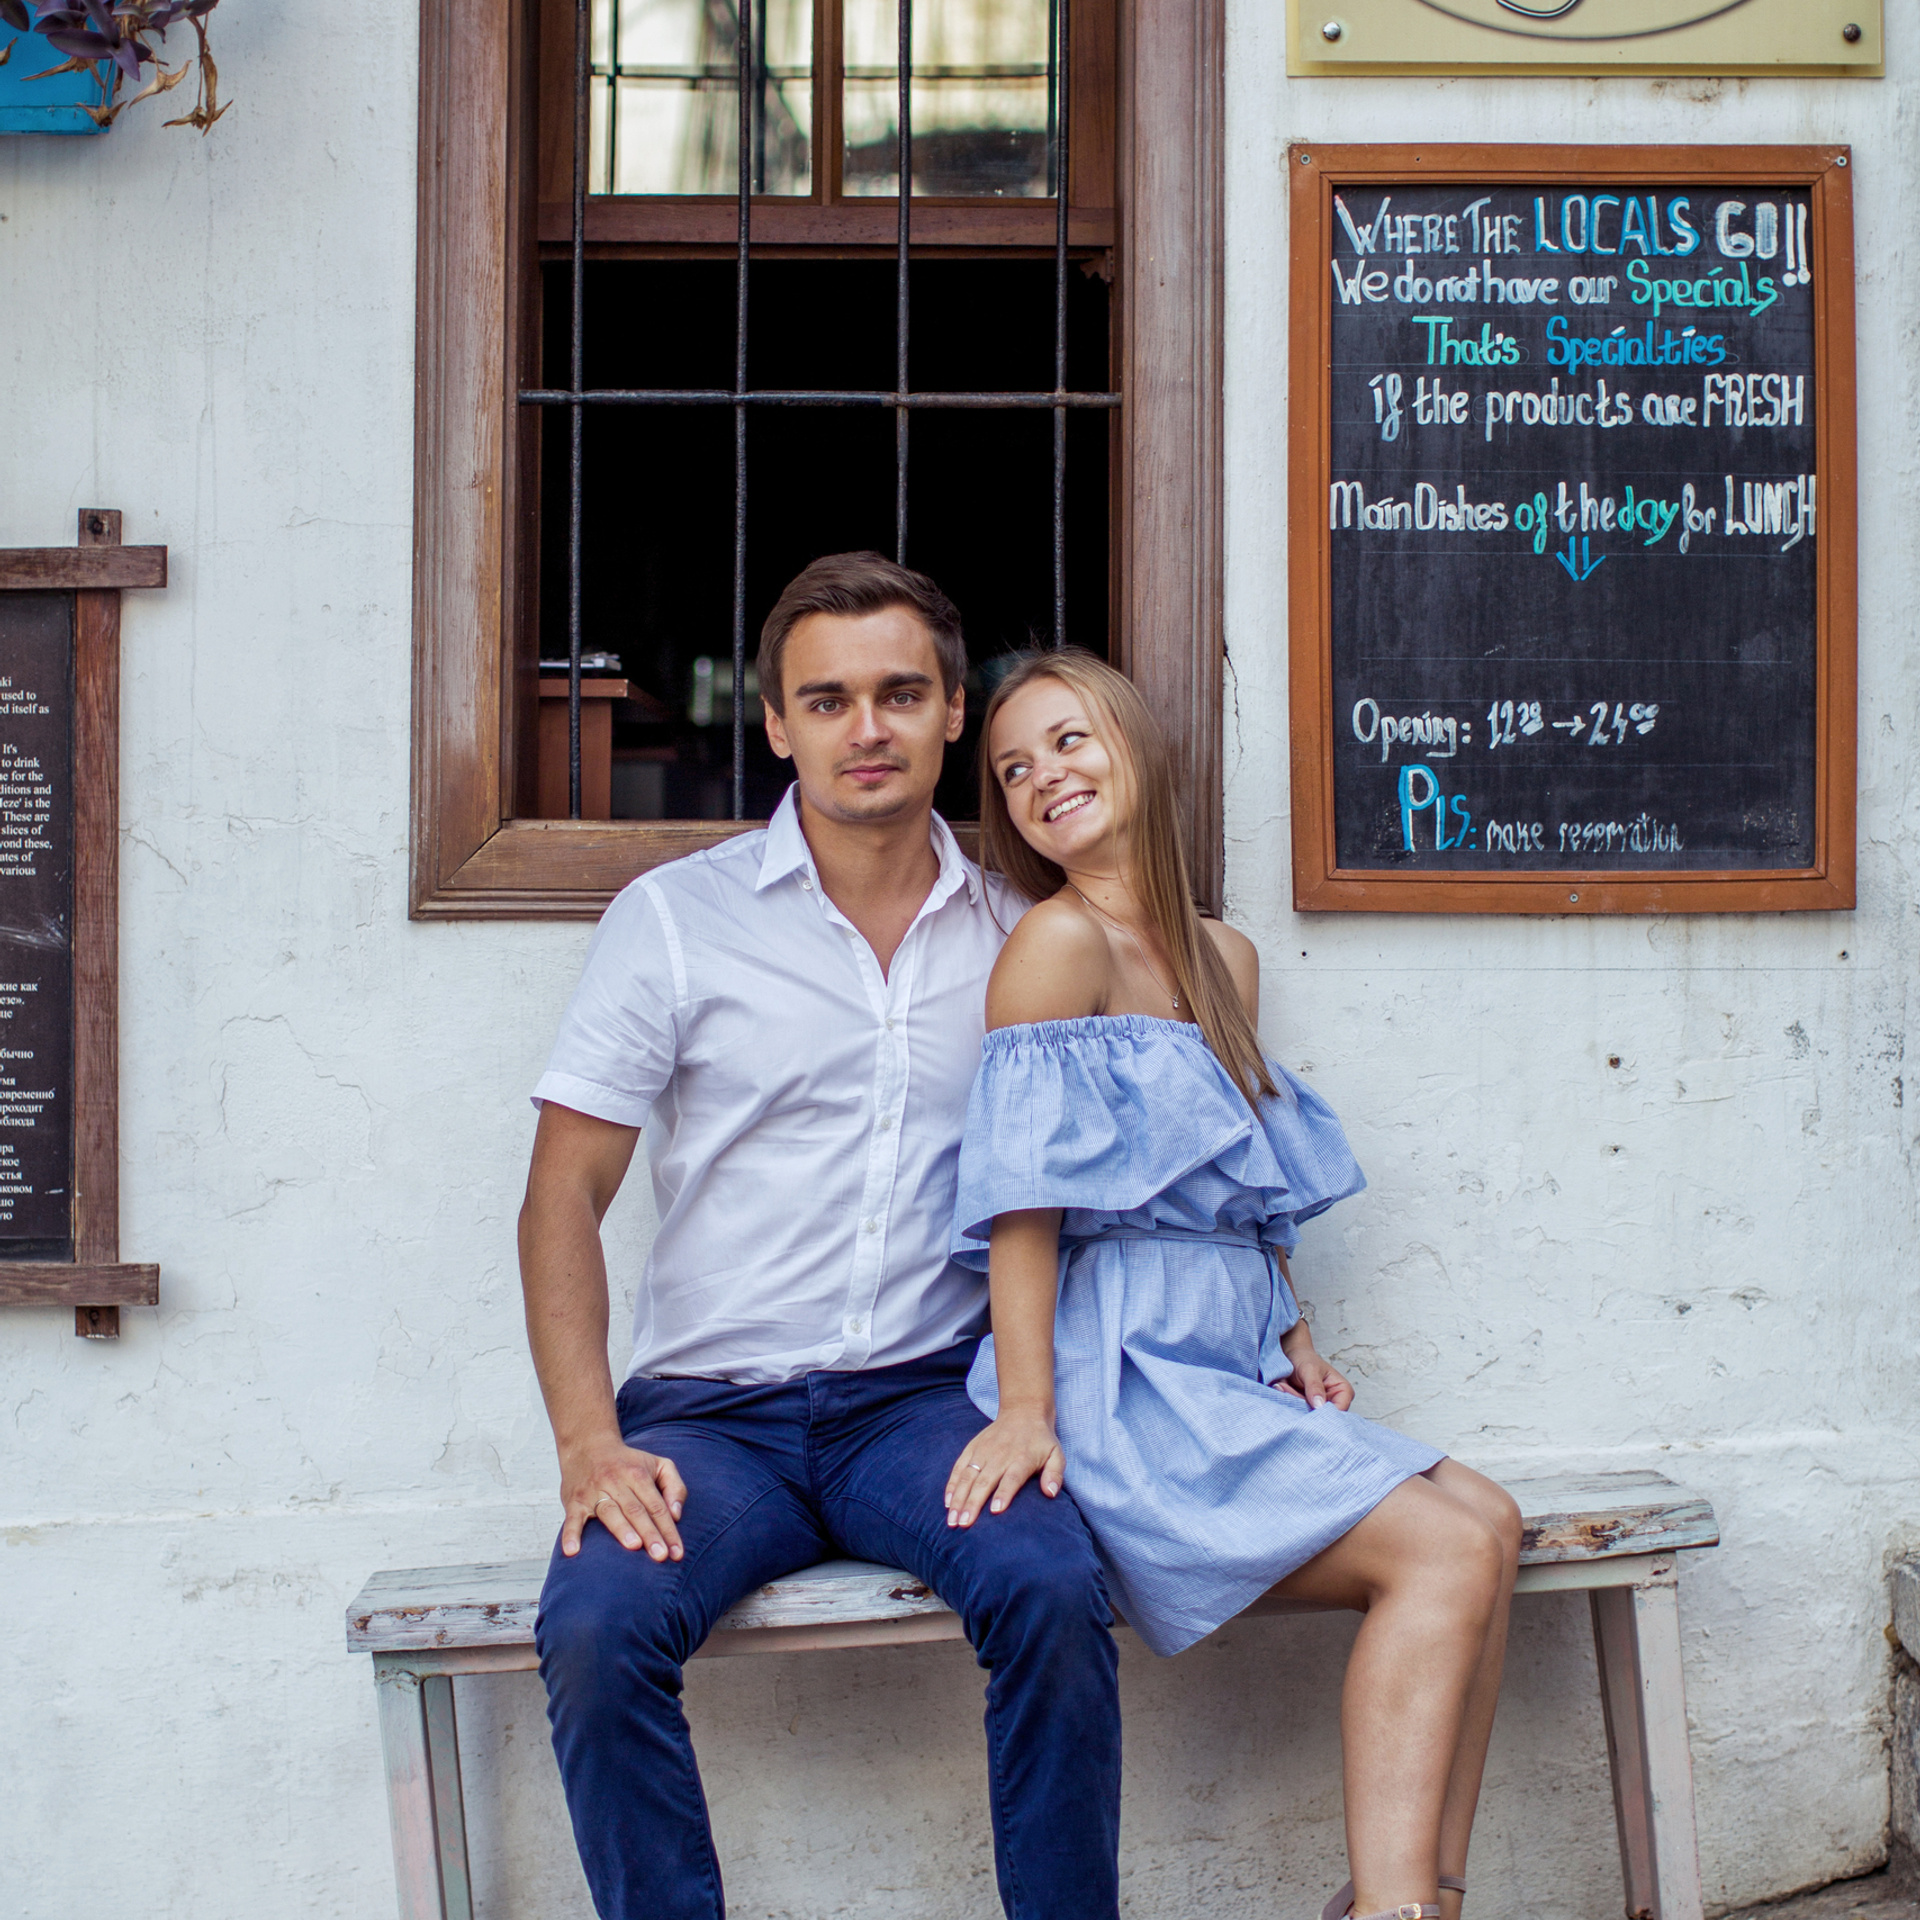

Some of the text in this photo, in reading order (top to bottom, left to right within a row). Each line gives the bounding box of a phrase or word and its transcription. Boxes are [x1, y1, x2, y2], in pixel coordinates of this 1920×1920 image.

[1334, 194, 1460, 255] WHERE
[1463, 197, 1523, 254] THE
[1534, 194, 1701, 256] LOCALS
[1331, 259, 1389, 305] We
[1394, 259, 1433, 304] do
[1483, 259, 1559, 304] have
[1568, 275, 1618, 305] our
[1626, 258, 1778, 317] Specials
[1412, 315, 1726, 375] That's Specialties
[1368, 373, 1403, 442] if
[1412, 376, 1469, 425] the
[1485, 377, 1633, 442] products
[1703, 373, 1804, 427] FRESH
[1330, 474, 1817, 555] Main Dishes of the day for LUNCH
[1, 690, 37, 701] used to
[12, 703, 38, 715] itself
[38, 705, 50, 715] as
[1352, 698, 1472, 763] Opening:
[3, 743, 18, 755] It's
[1, 757, 40, 768] to drink
[11, 771, 26, 782] for
[28, 771, 44, 782] the
[33, 784, 52, 795] and
[24, 797, 33, 809] is
[35, 797, 51, 809] the
[2, 811, 50, 822] These are
[1, 824, 44, 836] slices of
[1486, 819, 1545, 854] make
[25, 838, 53, 852] these,
[21, 851, 34, 863] of
[0, 864, 37, 876] various
[21, 983, 38, 992] как
